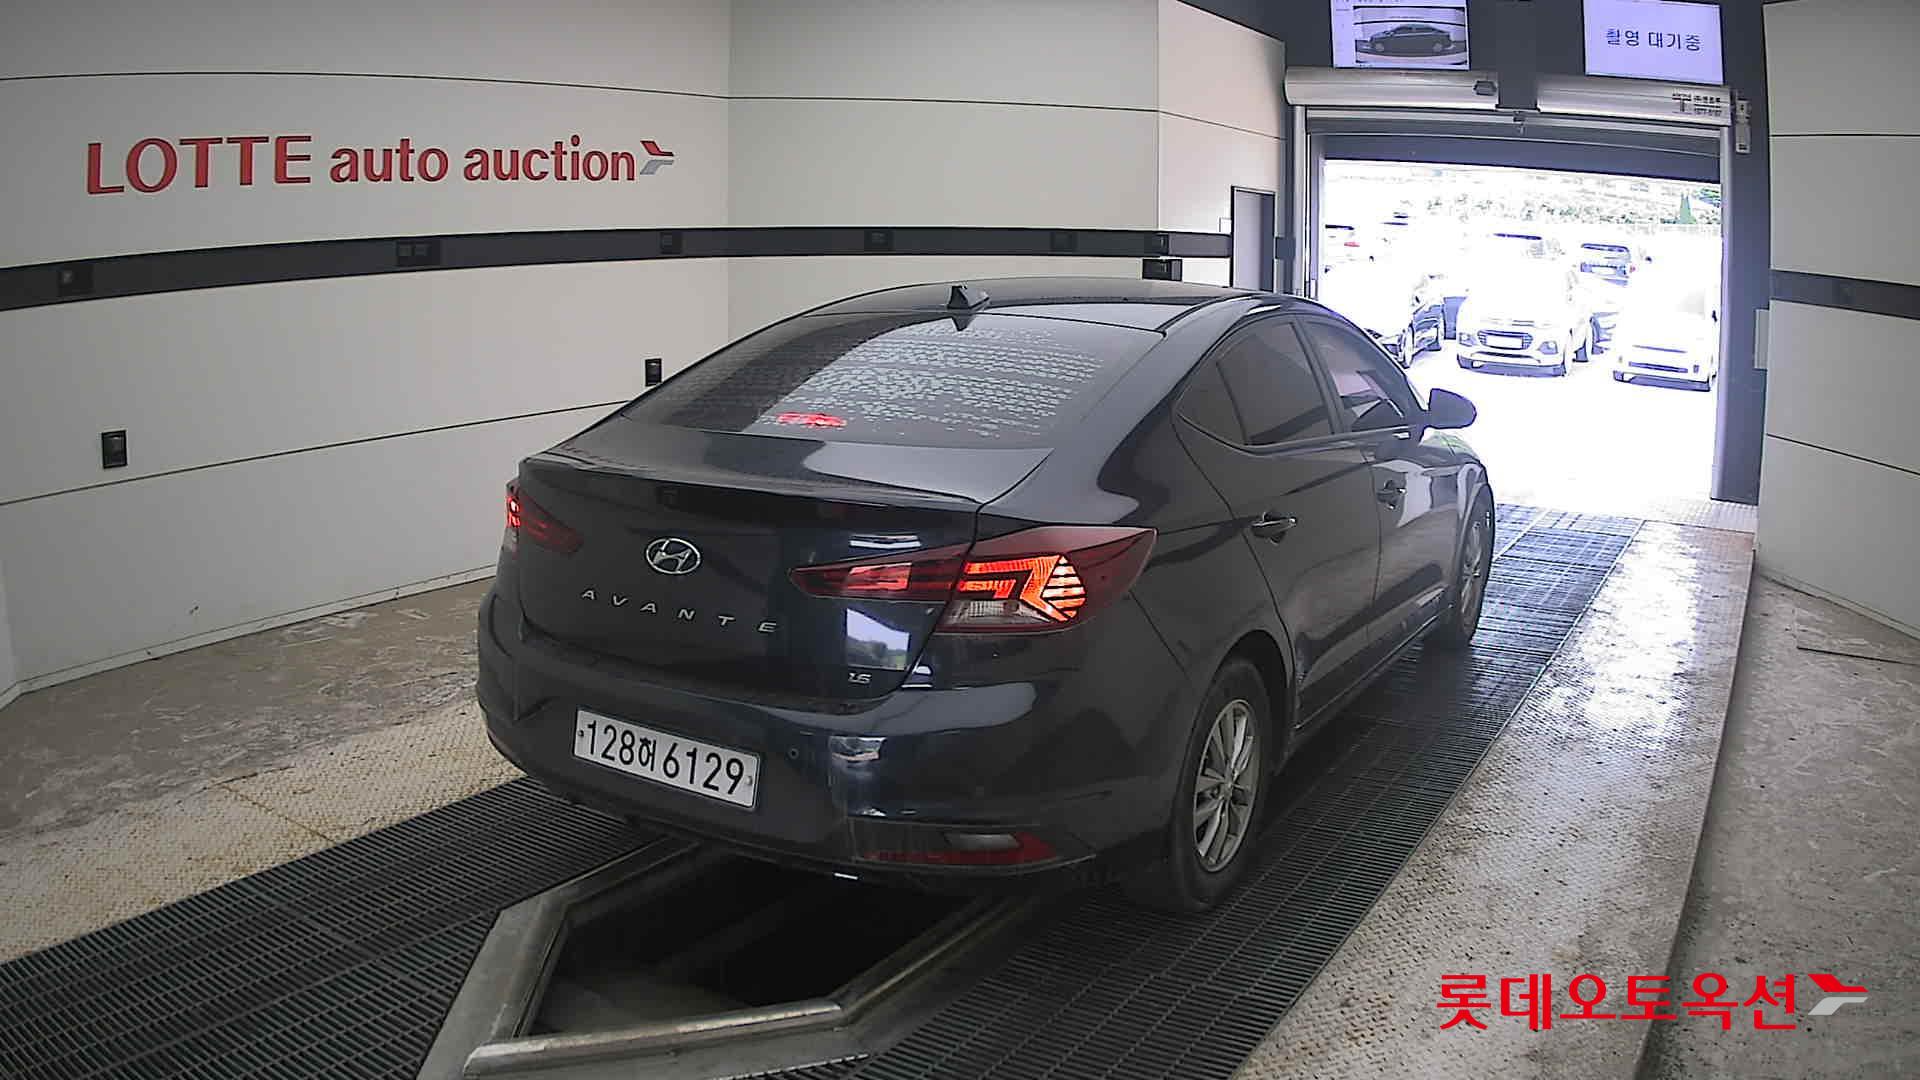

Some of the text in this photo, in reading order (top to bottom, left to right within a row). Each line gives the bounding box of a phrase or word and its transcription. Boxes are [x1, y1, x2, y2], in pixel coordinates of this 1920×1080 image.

[1647, 31, 1701, 52] 대기중
[86, 134, 637, 196] LOTTE auto auction
[581, 588, 778, 634] AVANTE
